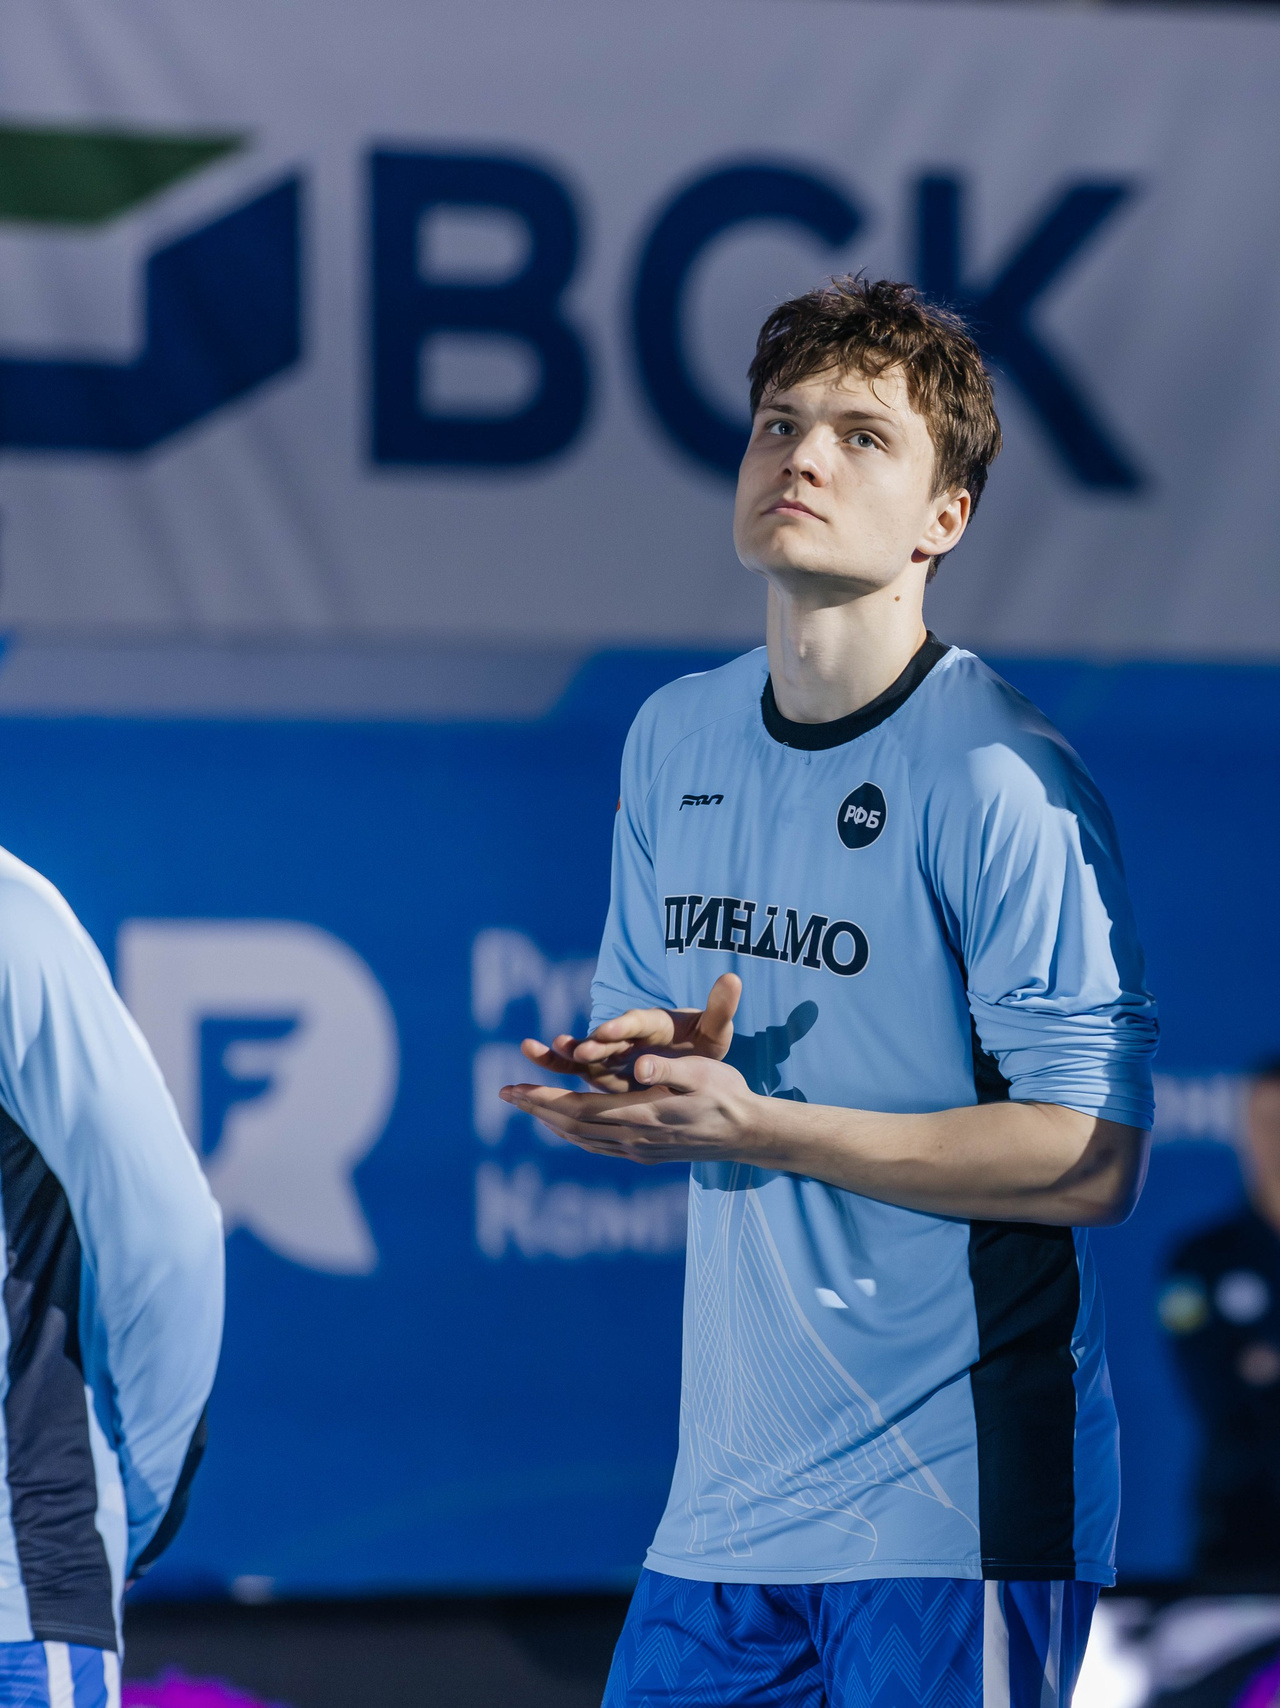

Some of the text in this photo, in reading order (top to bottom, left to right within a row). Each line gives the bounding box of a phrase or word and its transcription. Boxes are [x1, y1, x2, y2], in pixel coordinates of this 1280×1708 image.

[366, 144, 1152, 497] ВСК
[843, 804, 881, 829] РФБ
[664, 894, 870, 977] ДИНАМО
